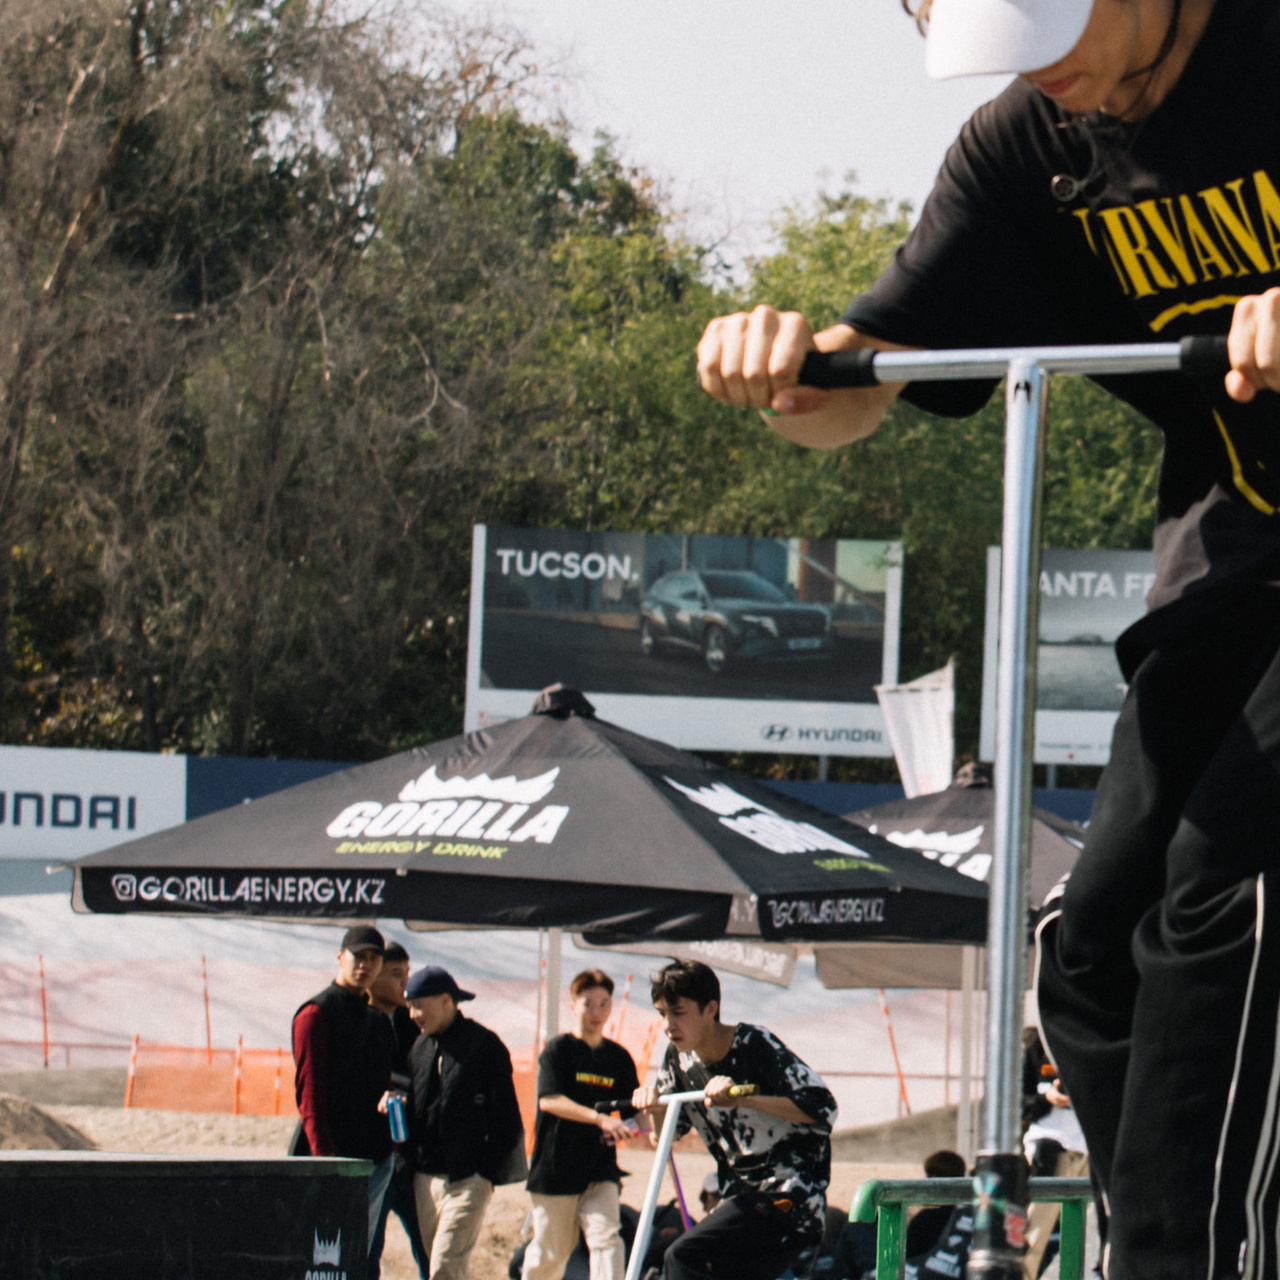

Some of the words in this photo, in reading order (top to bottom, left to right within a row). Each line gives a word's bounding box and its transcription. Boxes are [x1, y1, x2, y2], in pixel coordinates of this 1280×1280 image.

[496, 549, 640, 582] TUCSON.
[1039, 571, 1118, 598] ANTA
[798, 727, 883, 743] HYUNDAI
[0, 790, 137, 830] NDAI
[326, 800, 570, 844] GORILLA
[335, 840, 432, 855] ENERGY
[432, 841, 508, 859] DRINK
